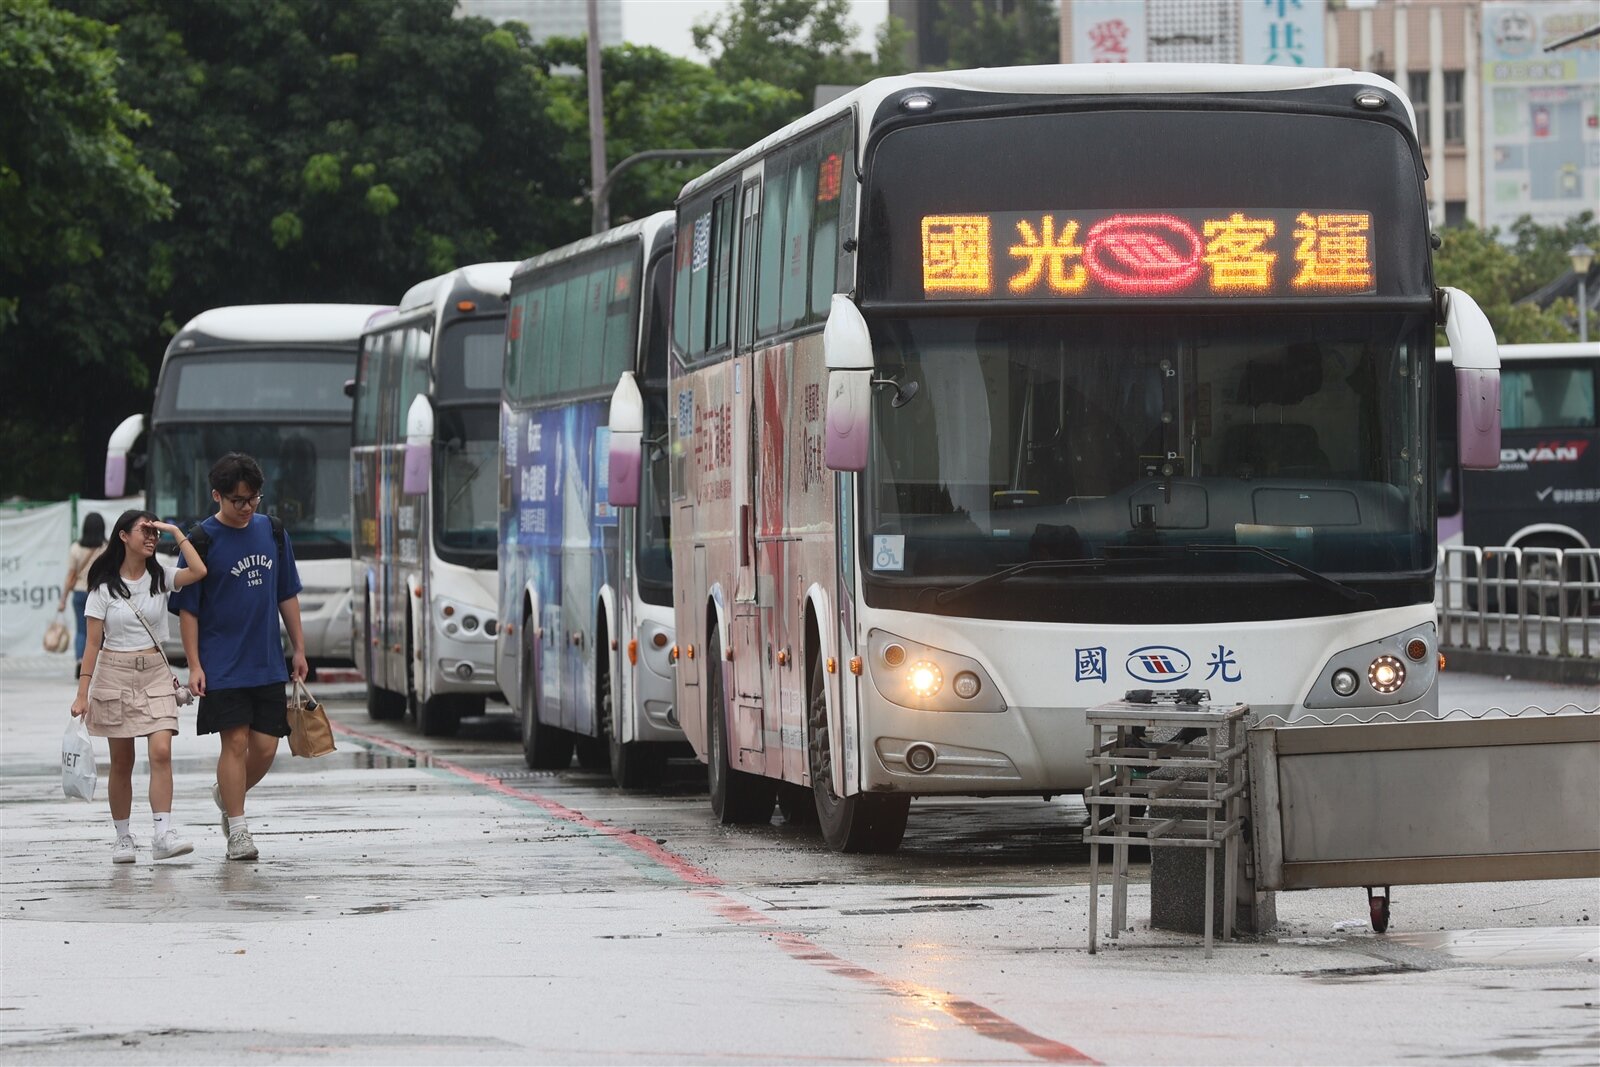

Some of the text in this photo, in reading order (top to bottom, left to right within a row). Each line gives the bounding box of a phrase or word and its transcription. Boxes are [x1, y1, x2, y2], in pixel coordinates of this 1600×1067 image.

[1200, 212, 1373, 293] 客運
[231, 554, 273, 577] NAUTICA
[247, 569, 262, 579] EST.
[247, 578, 262, 587] 1983
[1074, 645, 1242, 684] 國 光
[62, 751, 80, 768] NET
